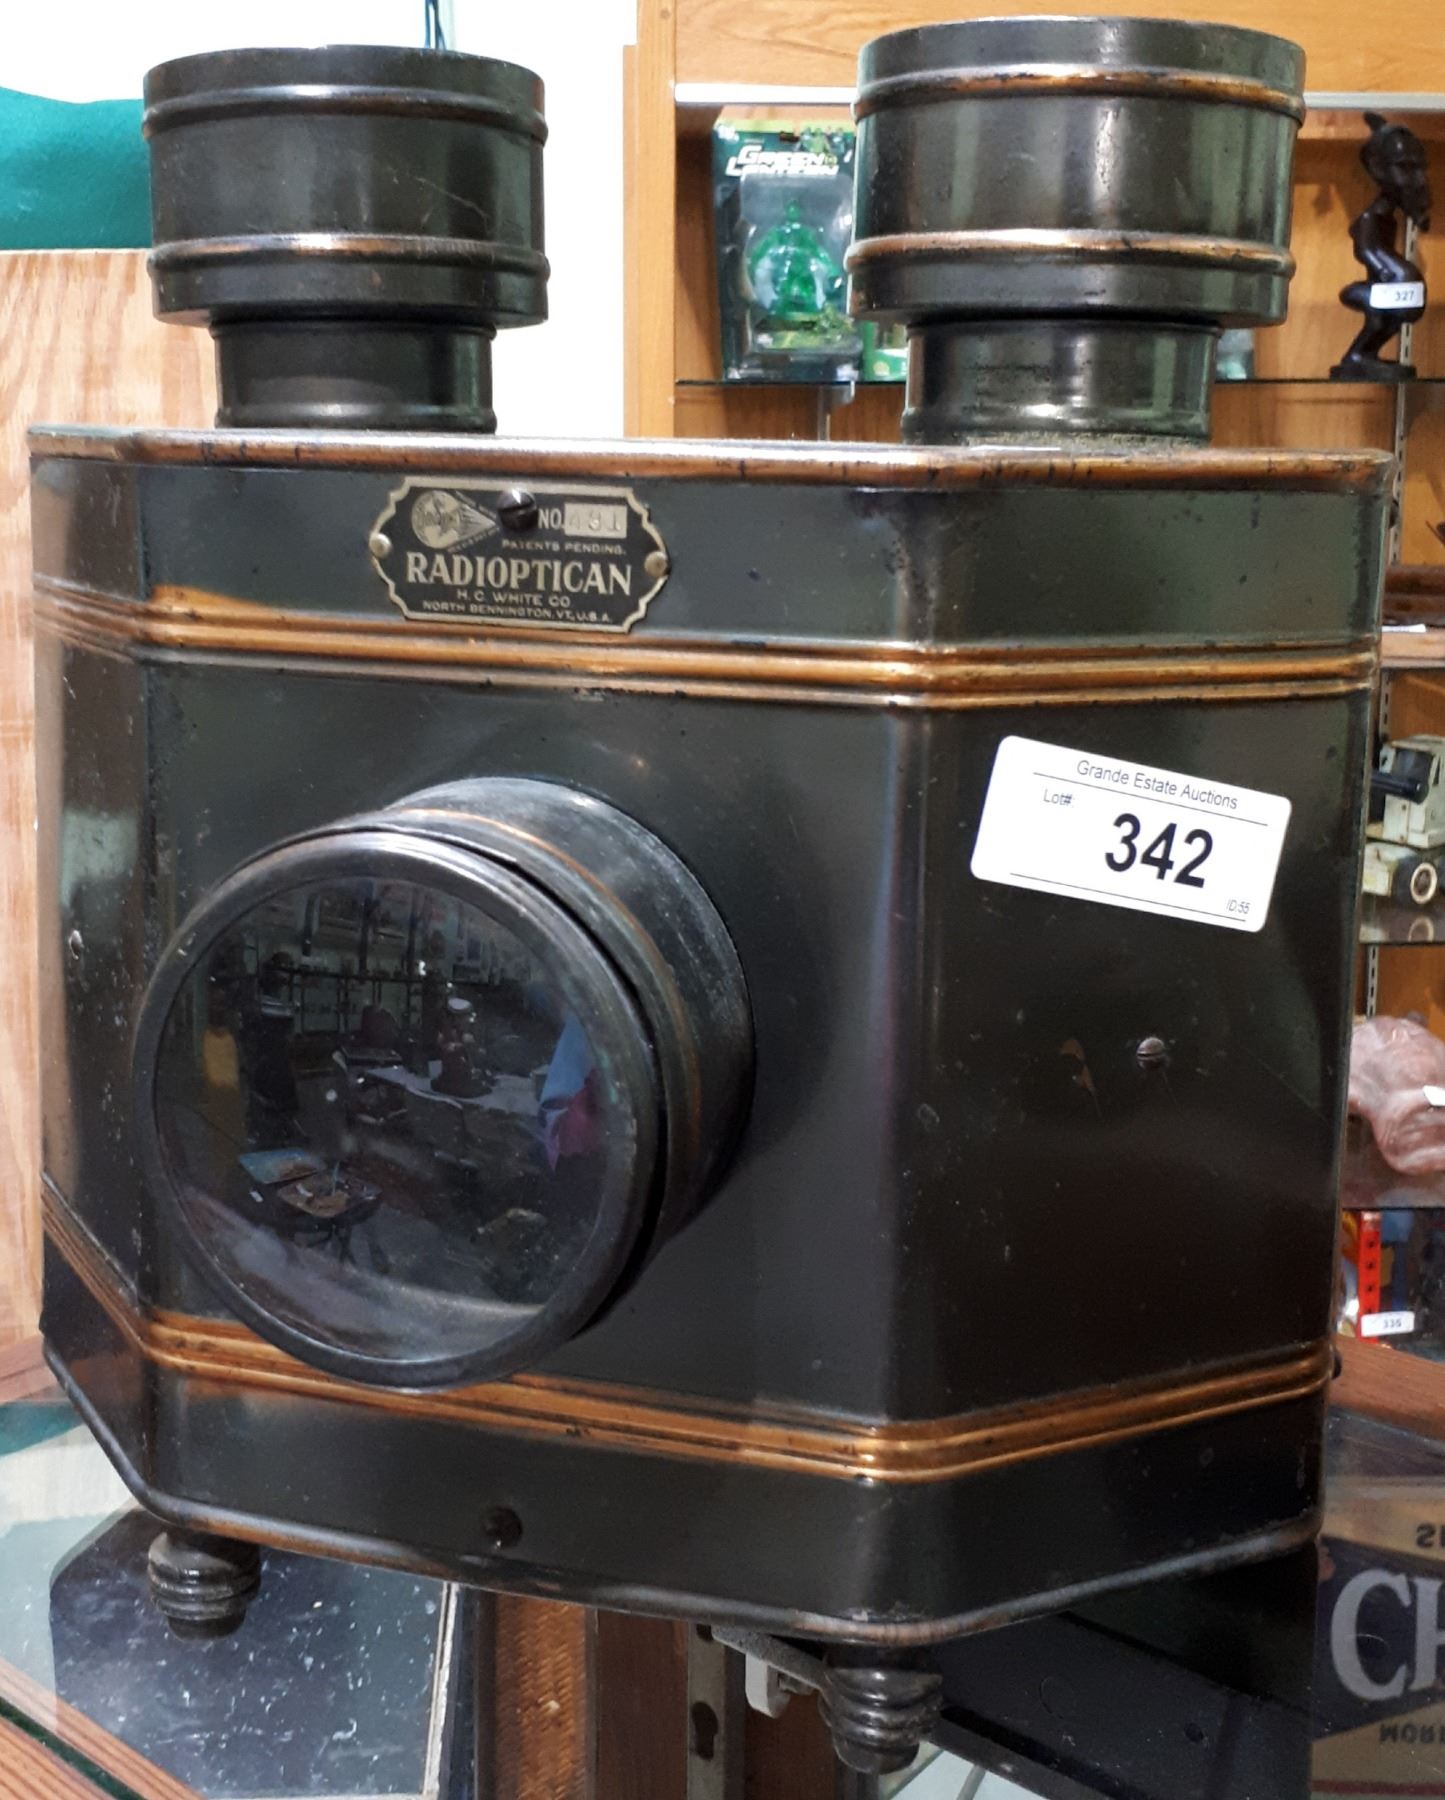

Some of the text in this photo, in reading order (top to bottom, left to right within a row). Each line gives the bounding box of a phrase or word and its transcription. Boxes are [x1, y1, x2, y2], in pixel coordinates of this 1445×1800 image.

[502, 539, 560, 552] PATENTS
[406, 552, 631, 596] RADIOPTICAN
[422, 600, 465, 612] NORTH
[492, 591, 543, 606] WHITE
[1077, 760, 1238, 810] Grande Estate Auctions
[1105, 813, 1213, 888] 342
